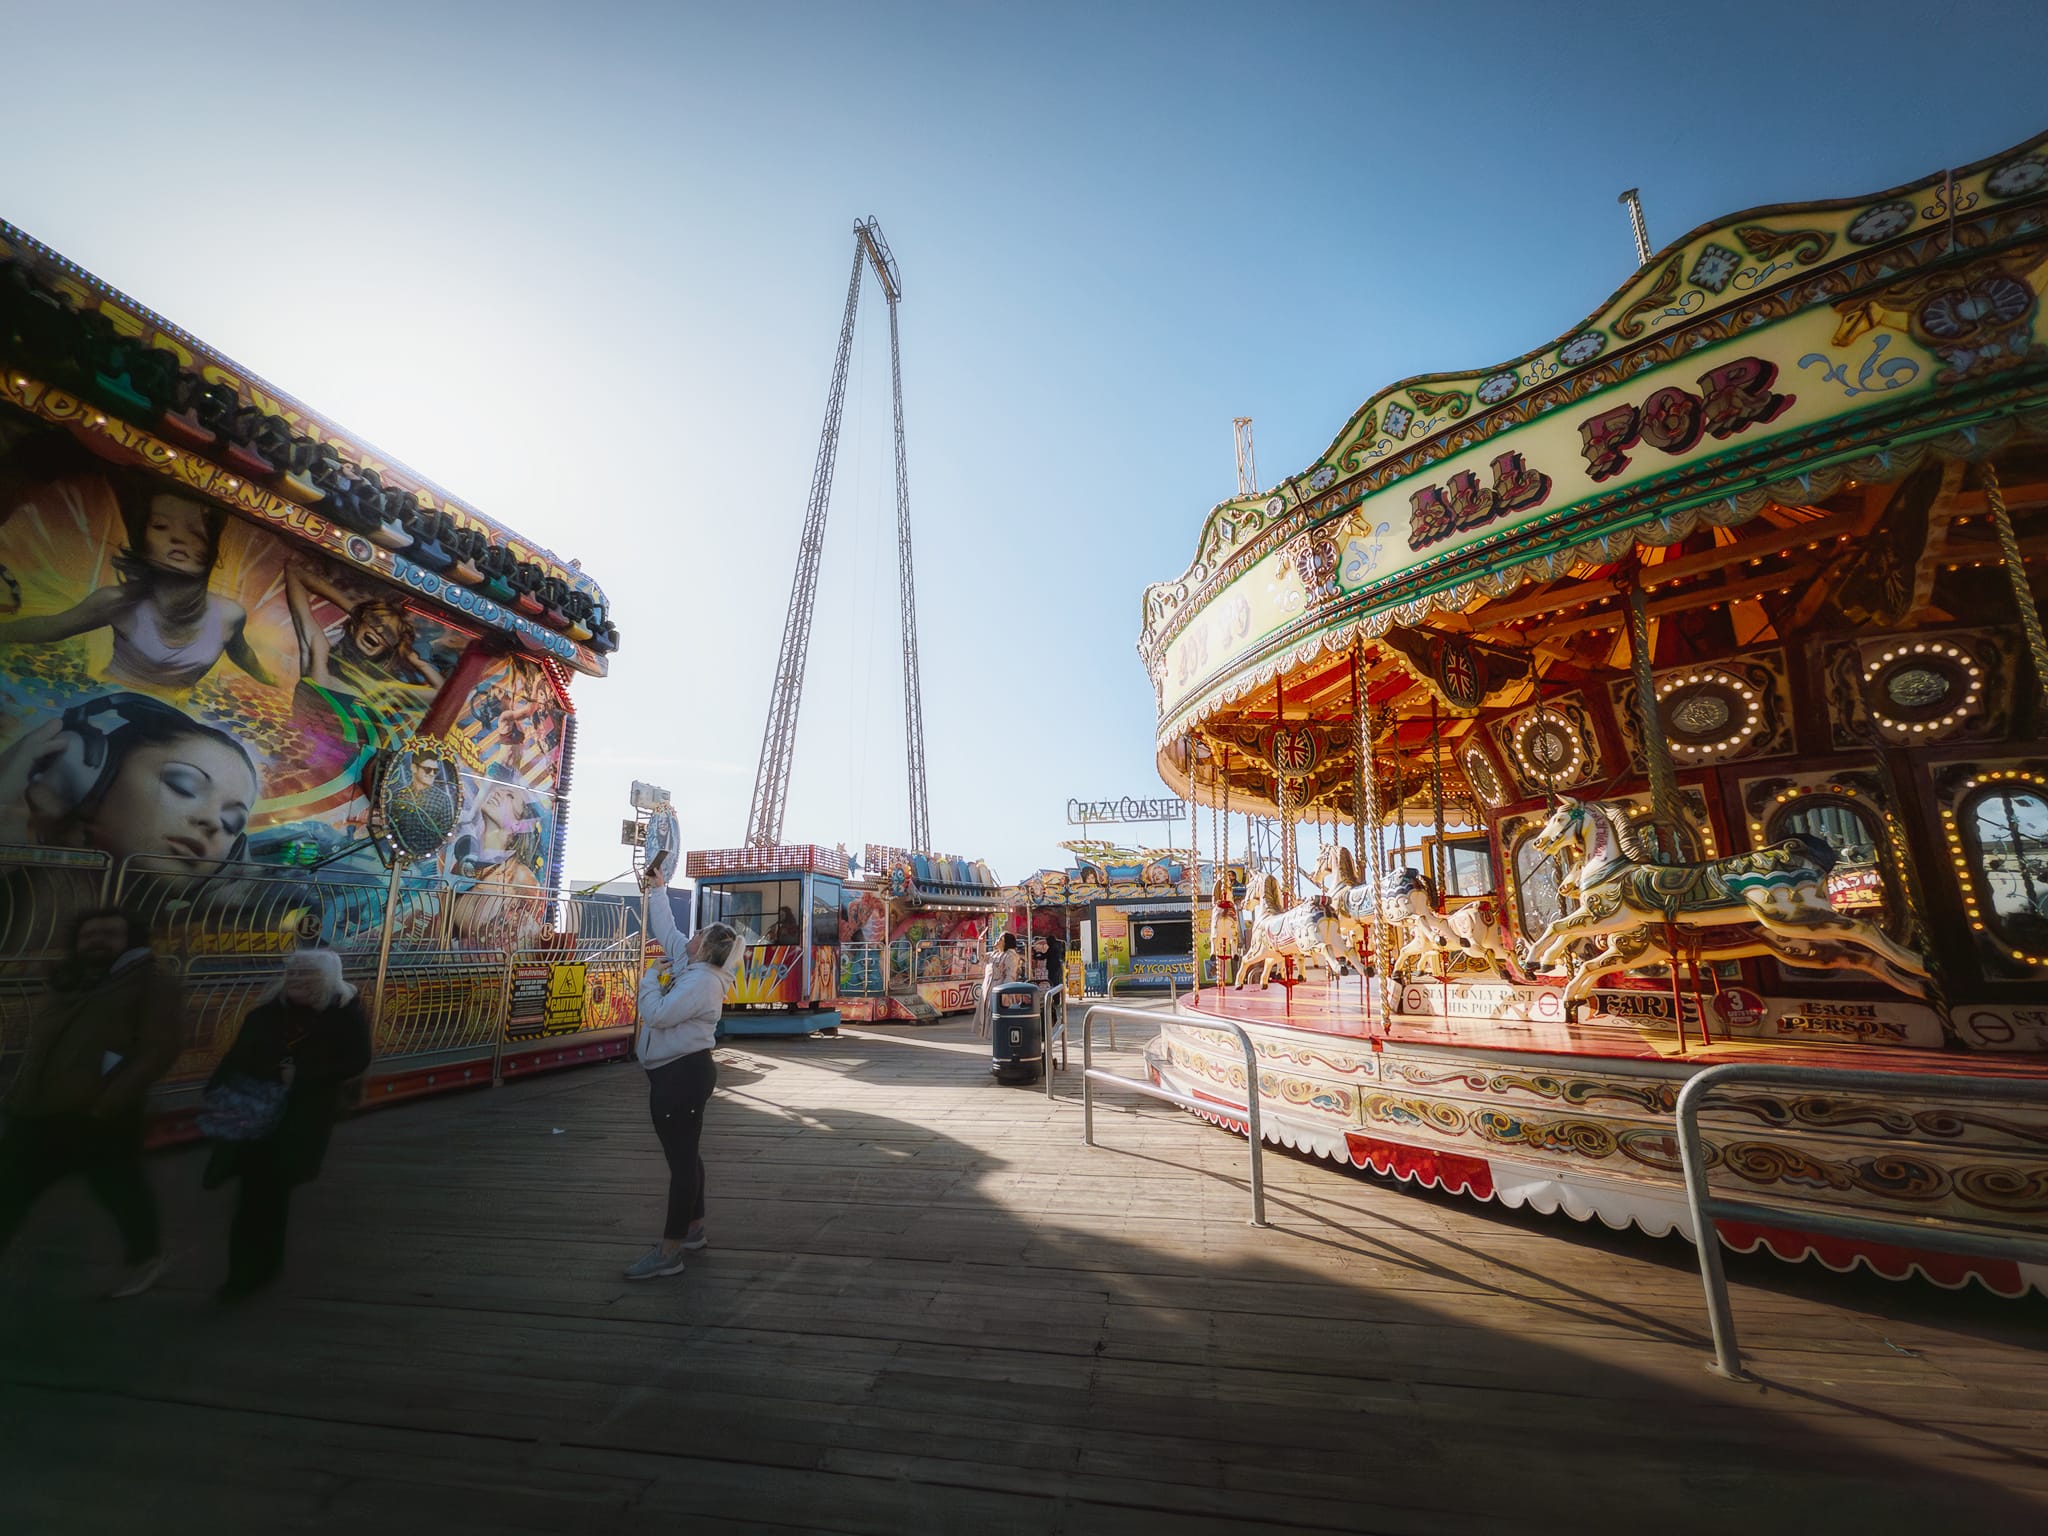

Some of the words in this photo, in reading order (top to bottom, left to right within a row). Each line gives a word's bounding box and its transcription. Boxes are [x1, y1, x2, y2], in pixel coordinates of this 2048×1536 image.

[1408, 450, 1552, 552] ALL
[1577, 356, 1797, 483] FOR
[391, 554, 440, 594] TOO
[445, 584, 500, 622] COLD
[1067, 797, 1119, 824] CRAZY
[1120, 795, 1186, 823] COASTER
[1422, 988, 1459, 1001] STAF
[1727, 991, 1745, 1010] 3
[1445, 1002, 1469, 1013] HIS
[1801, 1002, 1878, 1019] EACH
[1777, 1016, 1910, 1041] PERSON
